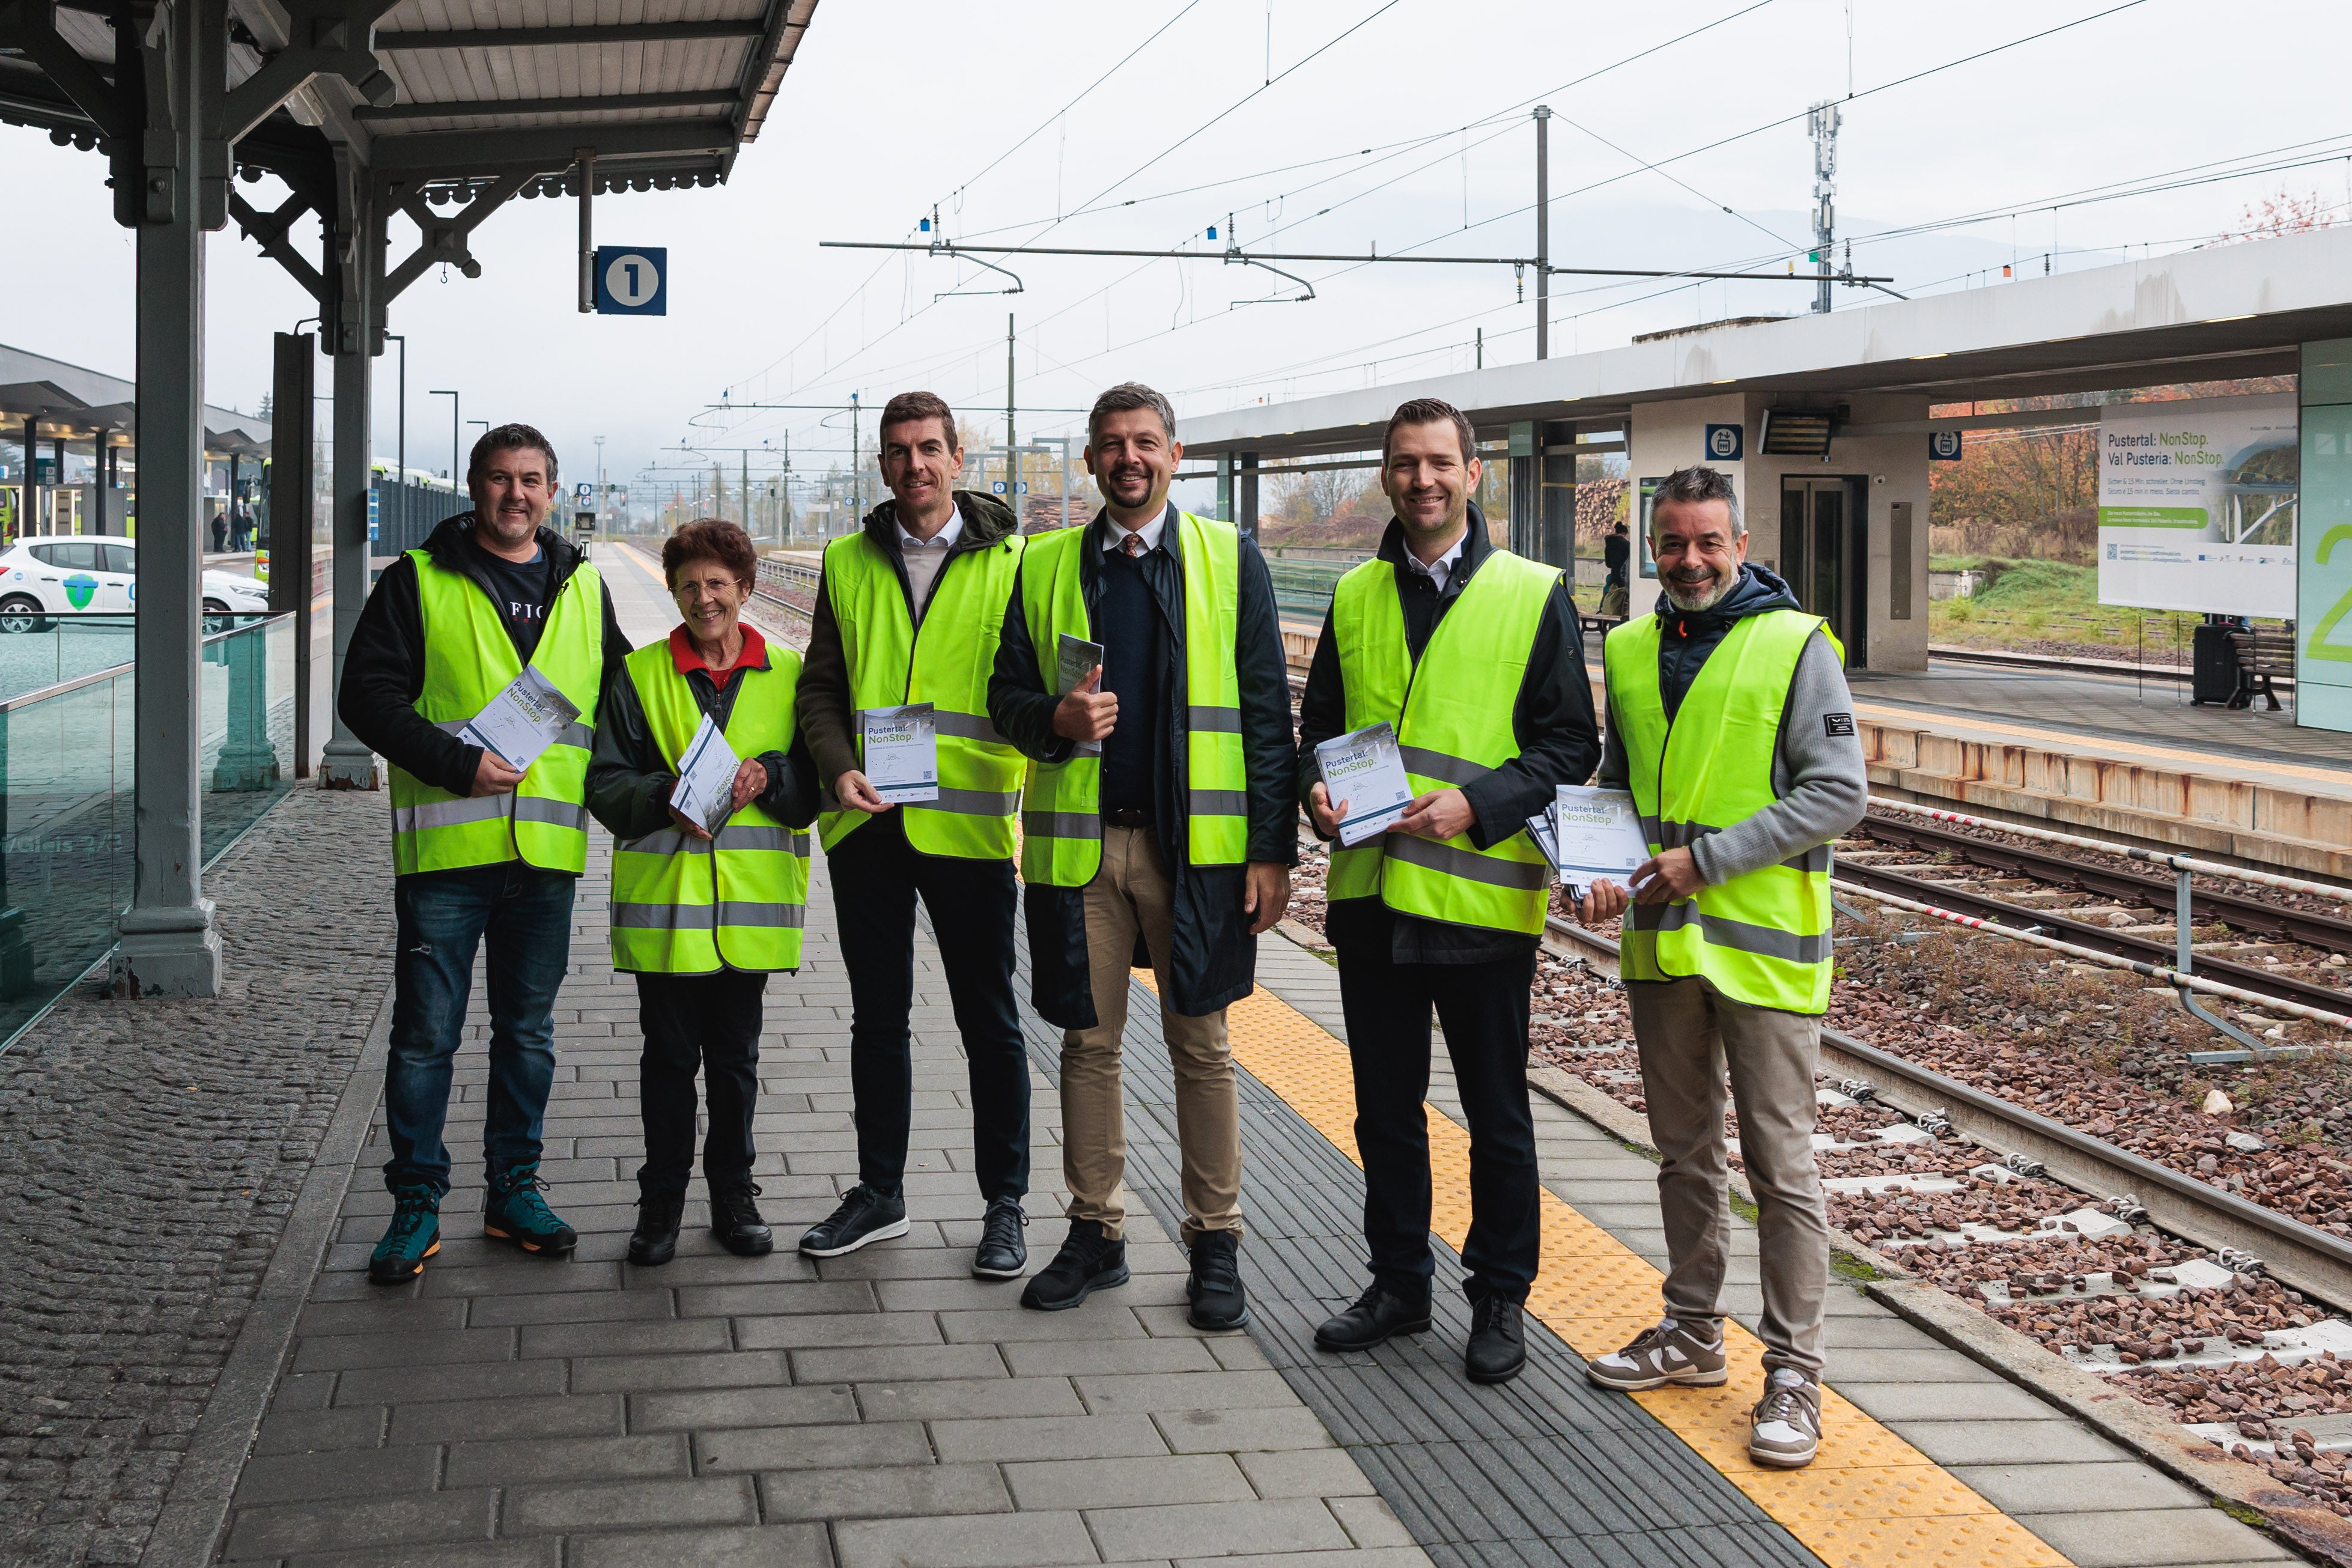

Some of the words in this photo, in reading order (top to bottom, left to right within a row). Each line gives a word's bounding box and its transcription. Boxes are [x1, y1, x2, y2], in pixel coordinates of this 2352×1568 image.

[624, 264, 639, 297] 1
[2109, 433, 2156, 447] Pustertal:
[2159, 431, 2208, 449] NonStop.
[2108, 452, 2123, 465] Val
[2127, 451, 2171, 466] Pusteria:
[2175, 451, 2225, 468] NonStop.
[506, 687, 541, 725] NonStop.
[514, 681, 545, 714] Pustertal:
[868, 724, 908, 735] Pustertal:
[869, 733, 914, 744] NonStop.
[1325, 750, 1368, 769] Pustertal:
[1328, 758, 1377, 779] NonStop.
[715, 760, 740, 794] NonStop.
[1562, 804, 1607, 814] Pustertal:
[1563, 813, 1614, 825] NonStop.
